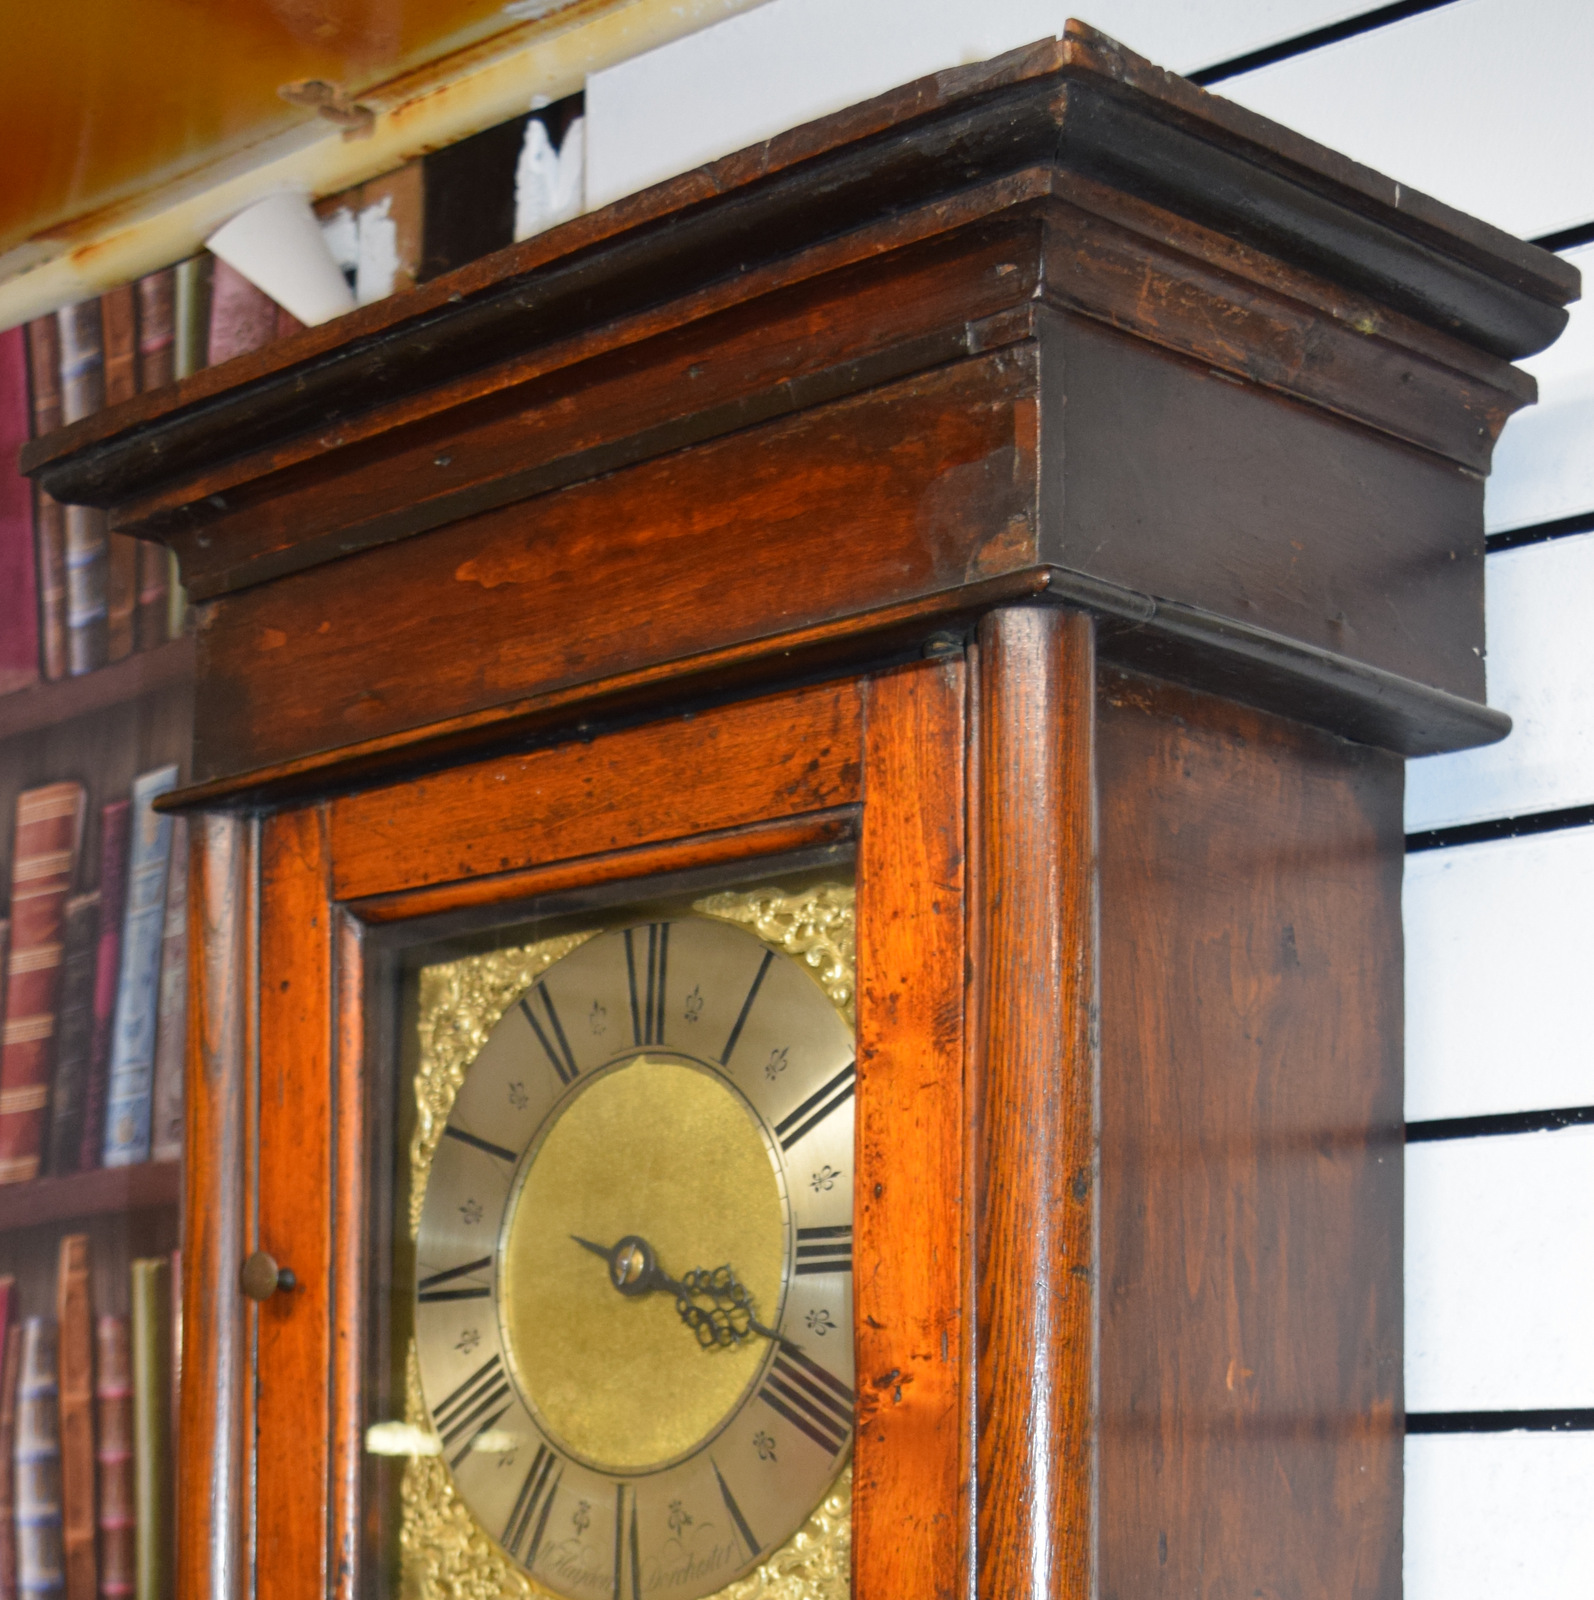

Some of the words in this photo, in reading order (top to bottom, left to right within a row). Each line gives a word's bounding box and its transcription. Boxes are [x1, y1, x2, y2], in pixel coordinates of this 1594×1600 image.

[614, 922, 675, 1050] XII
[715, 947, 778, 1069] I
[775, 1062, 855, 1151] II
[796, 1225, 854, 1275] III
[759, 1339, 855, 1457] IIII
